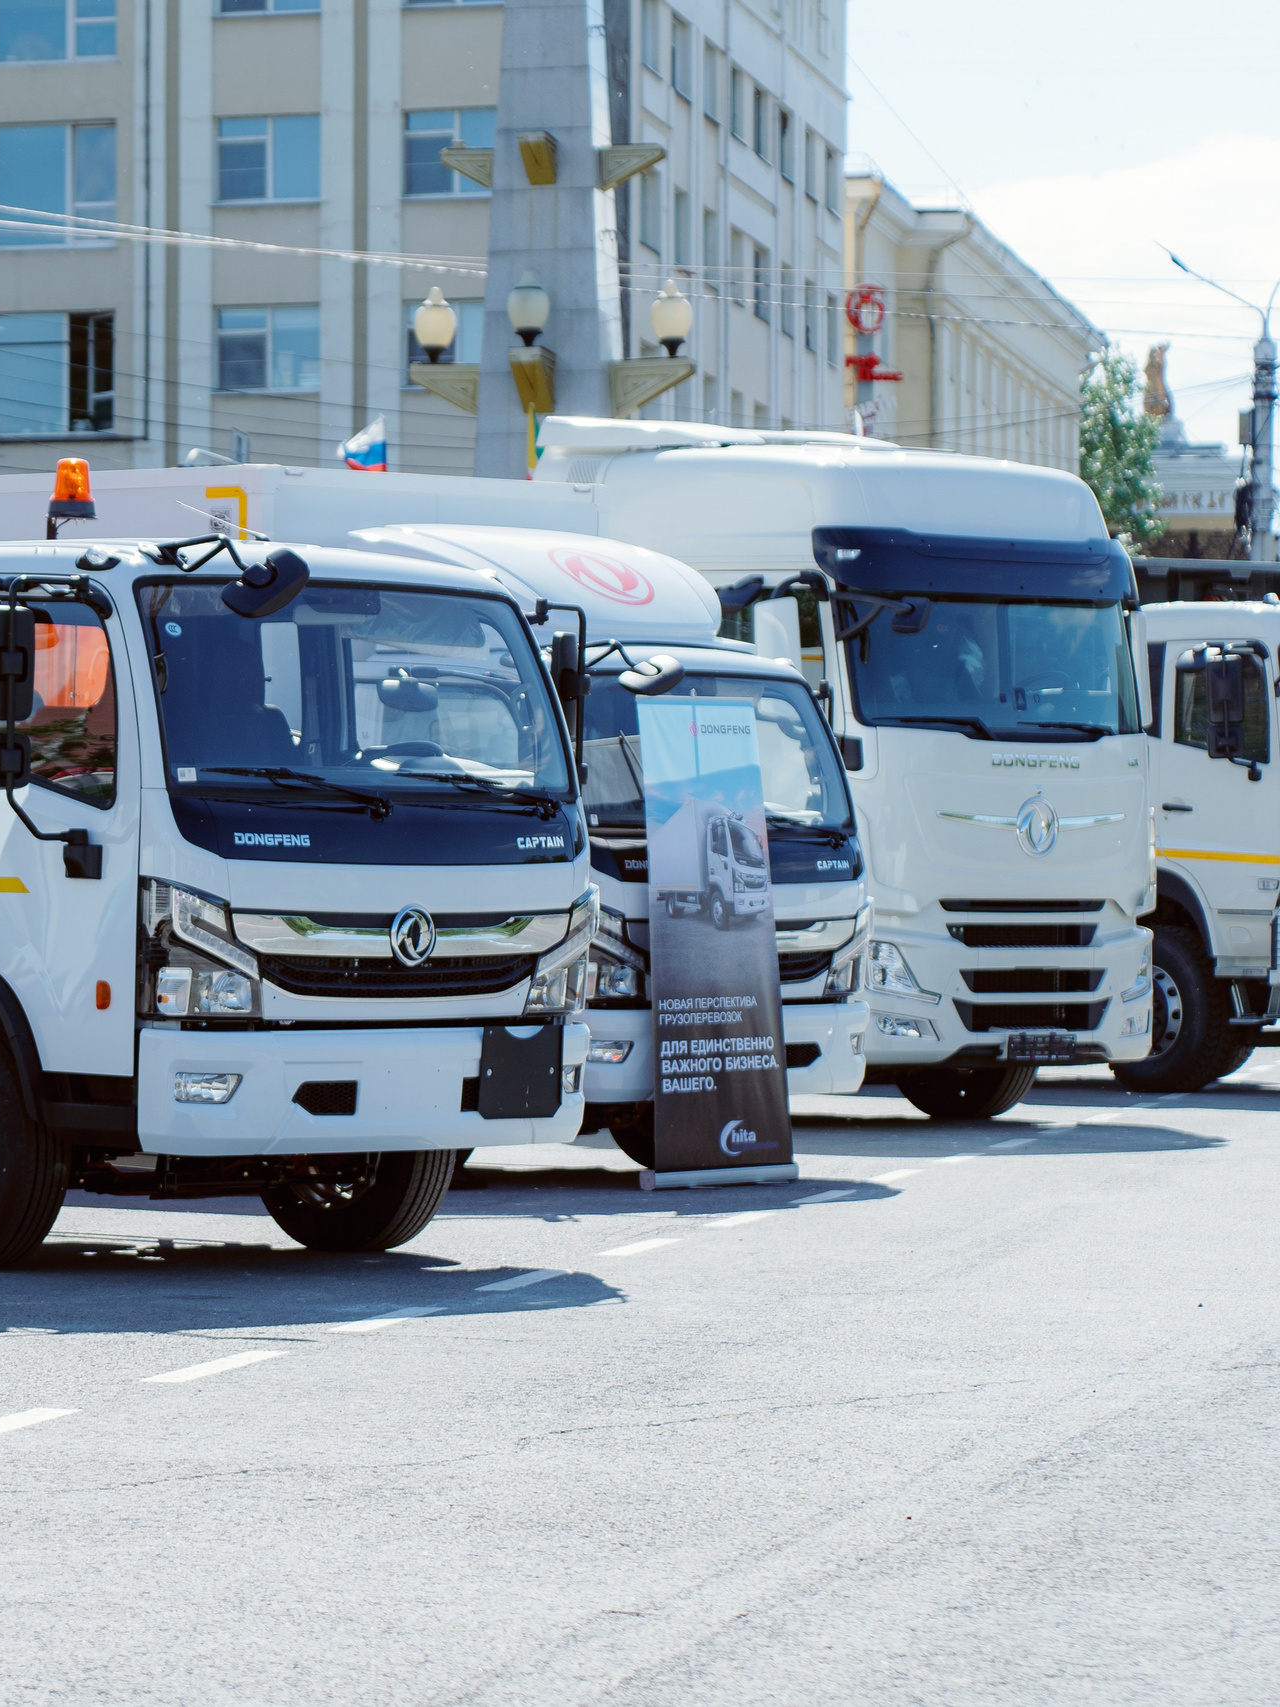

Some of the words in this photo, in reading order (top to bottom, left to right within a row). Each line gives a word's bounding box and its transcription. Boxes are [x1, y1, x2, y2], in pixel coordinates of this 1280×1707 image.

[700, 724, 751, 735] DONGFENG
[991, 752, 1080, 769] DONGFENG
[233, 832, 311, 846] DONGFENG
[516, 836, 565, 849] CAPTAIN
[816, 860, 850, 870] CAPTAIN
[658, 999, 694, 1011] НОВАЯ
[694, 995, 758, 1009] ПЕРСПЕКТИВА
[659, 1010, 744, 1026] ГРУЗОПЕРЕВОЗОК
[660, 1040, 688, 1058] ДЛЯ
[690, 1035, 775, 1056] ЕДИНСТВЕННО
[661, 1056, 723, 1074] ВАЖНОГО
[724, 1054, 780, 1071] БИЗНЕСА.
[662, 1076, 718, 1094] ВАШЕГО.
